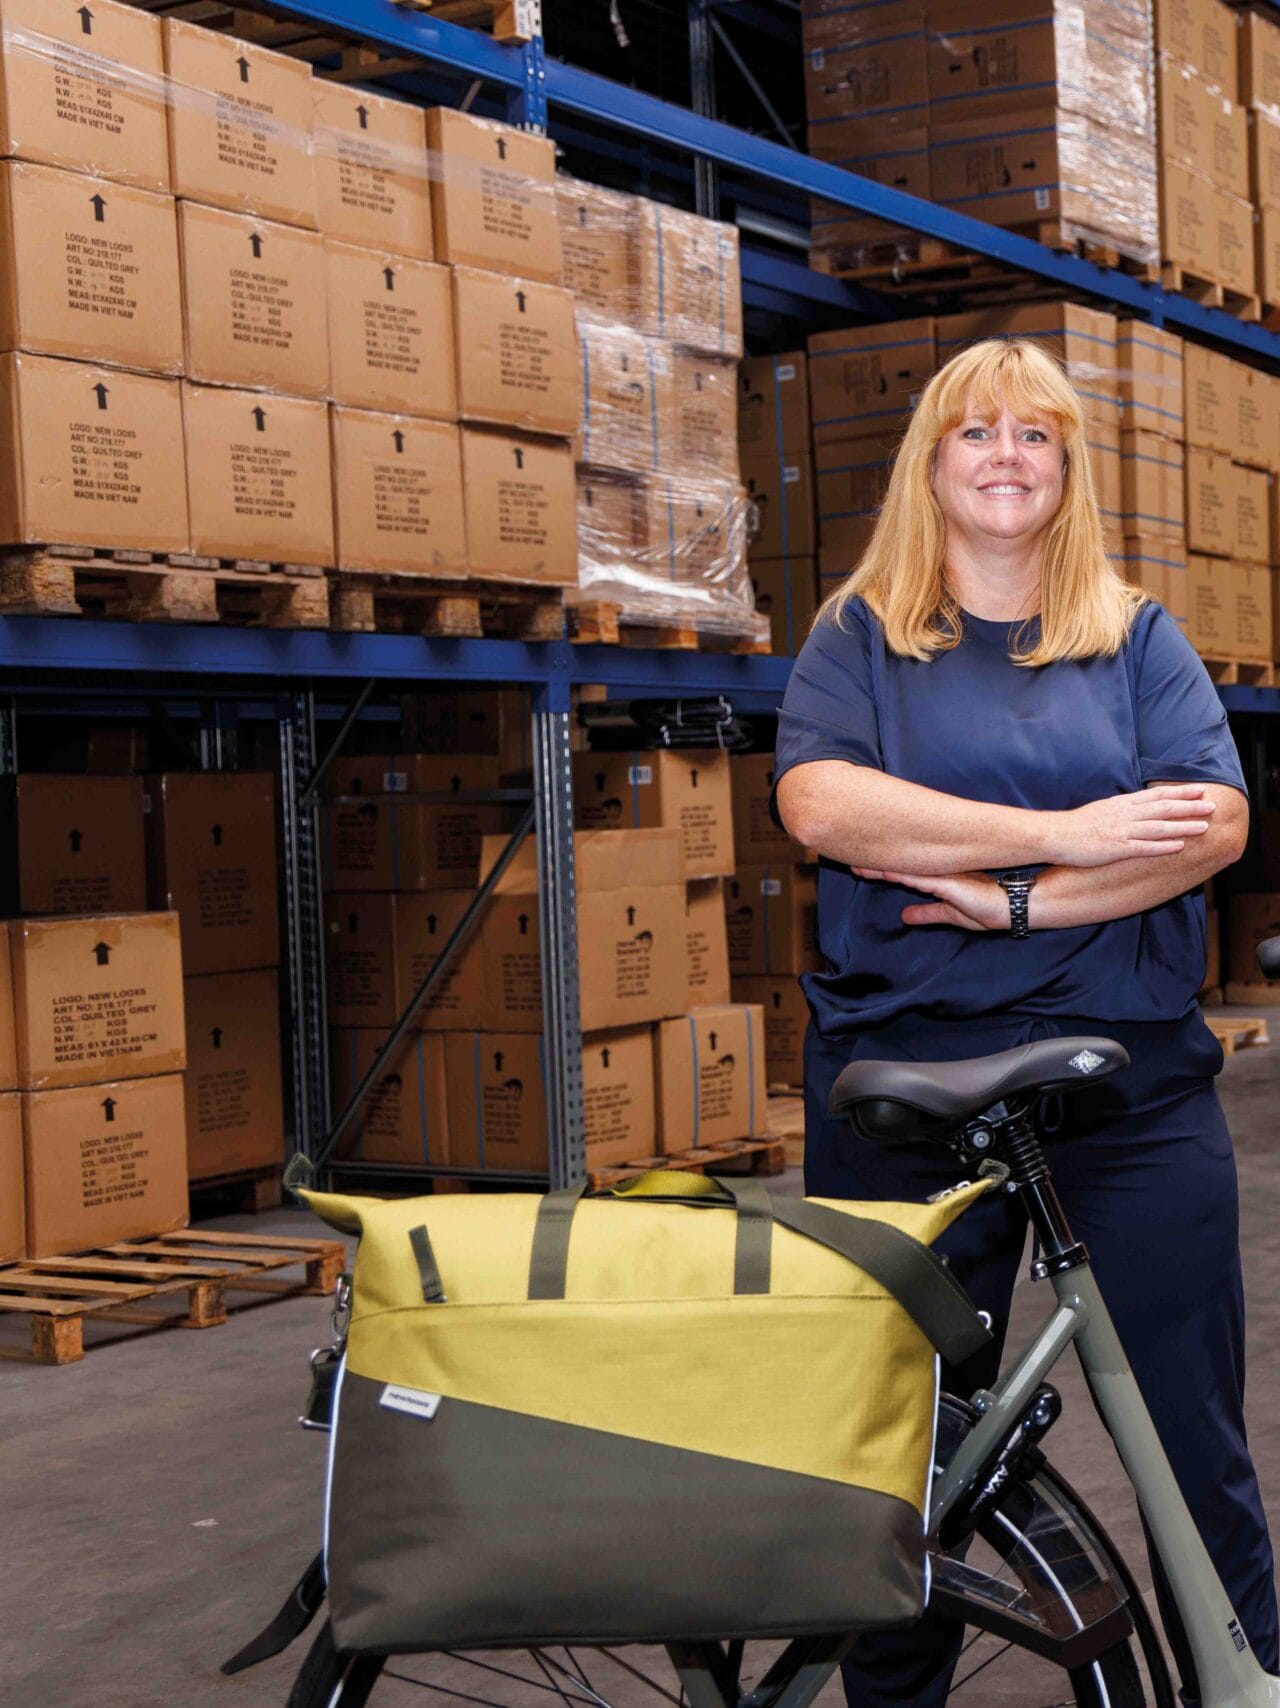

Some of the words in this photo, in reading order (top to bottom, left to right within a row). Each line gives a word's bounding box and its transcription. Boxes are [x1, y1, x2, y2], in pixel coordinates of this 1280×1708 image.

[69, 301, 89, 312] MADE
[92, 305, 99, 313] IN
[101, 306, 116, 316] VIET
[118, 310, 133, 319] NAM
